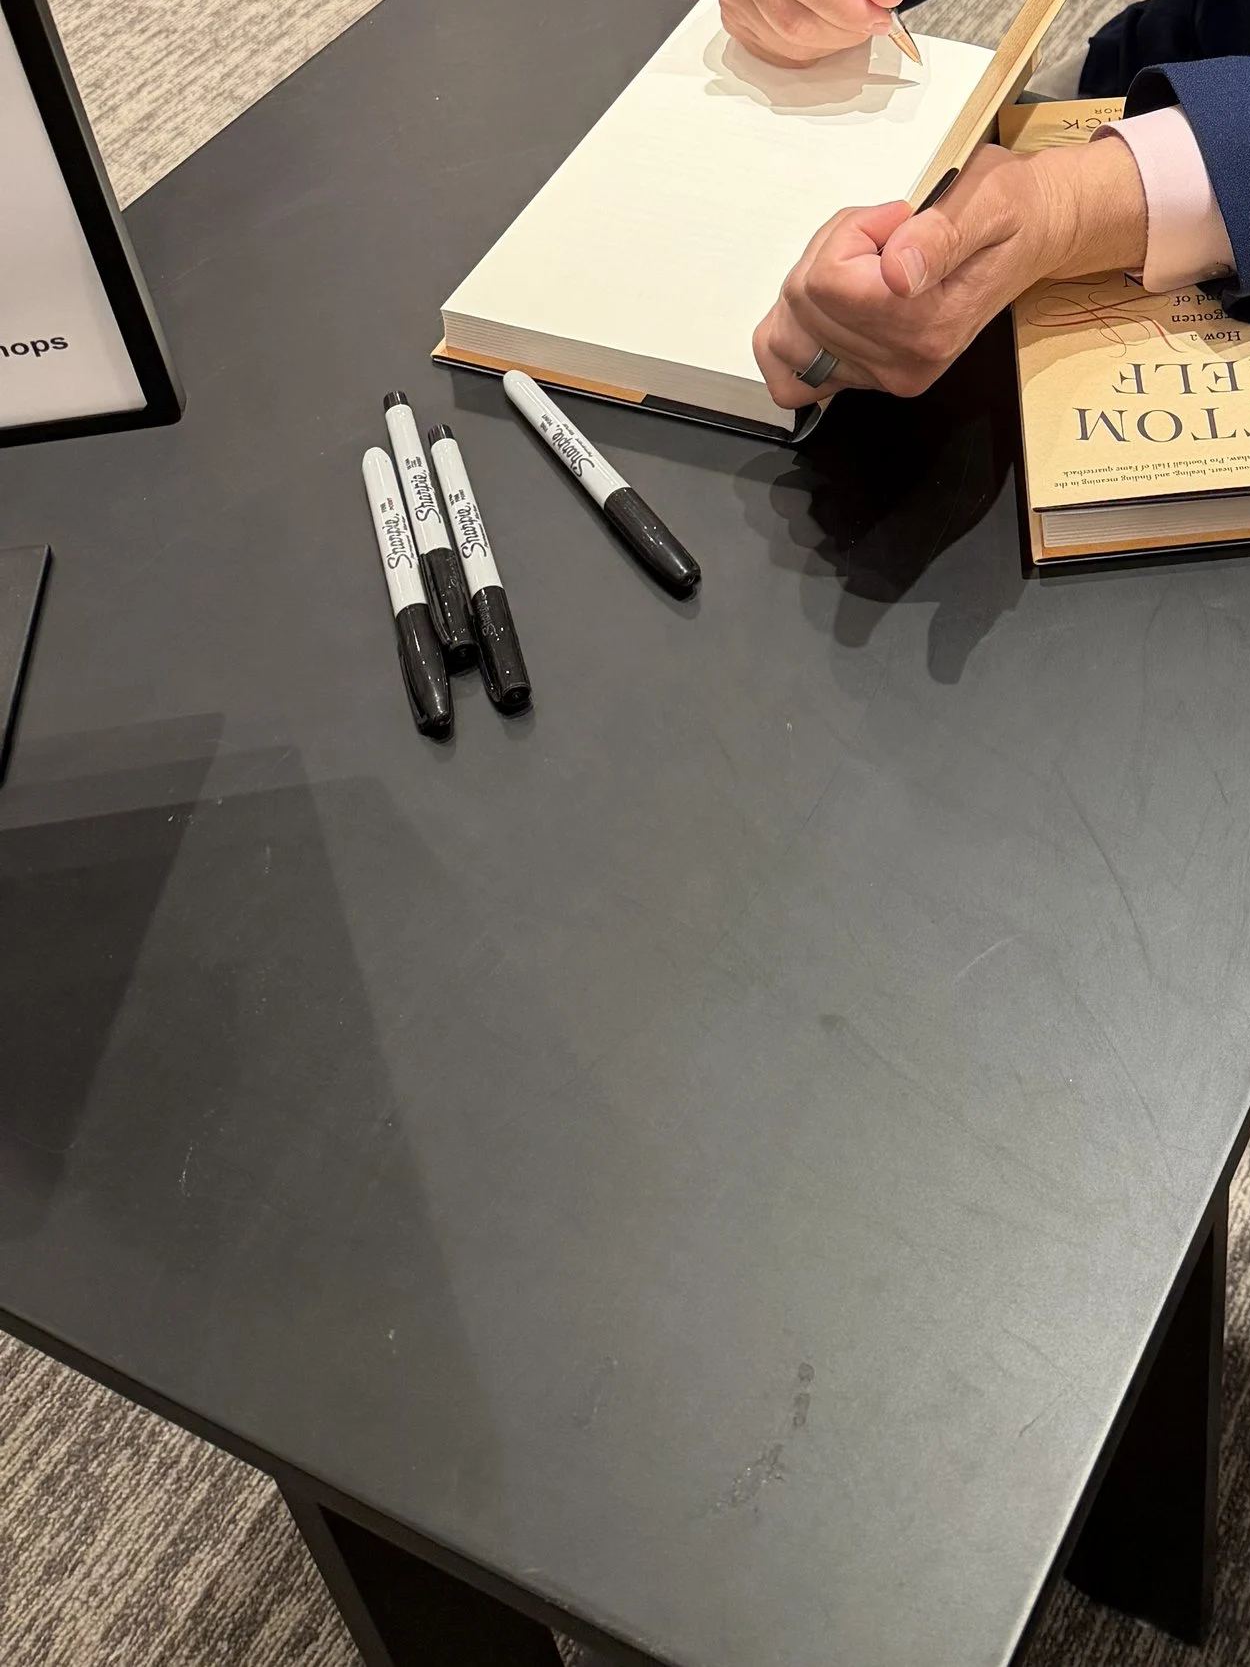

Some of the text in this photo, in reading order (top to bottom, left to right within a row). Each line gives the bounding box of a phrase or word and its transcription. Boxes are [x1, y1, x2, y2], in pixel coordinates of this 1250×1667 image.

[1173, 294, 1192, 307] of
[1189, 329, 1242, 342] How a
[1155, 471, 1170, 479] and
[1081, 476, 1119, 486] meaning
